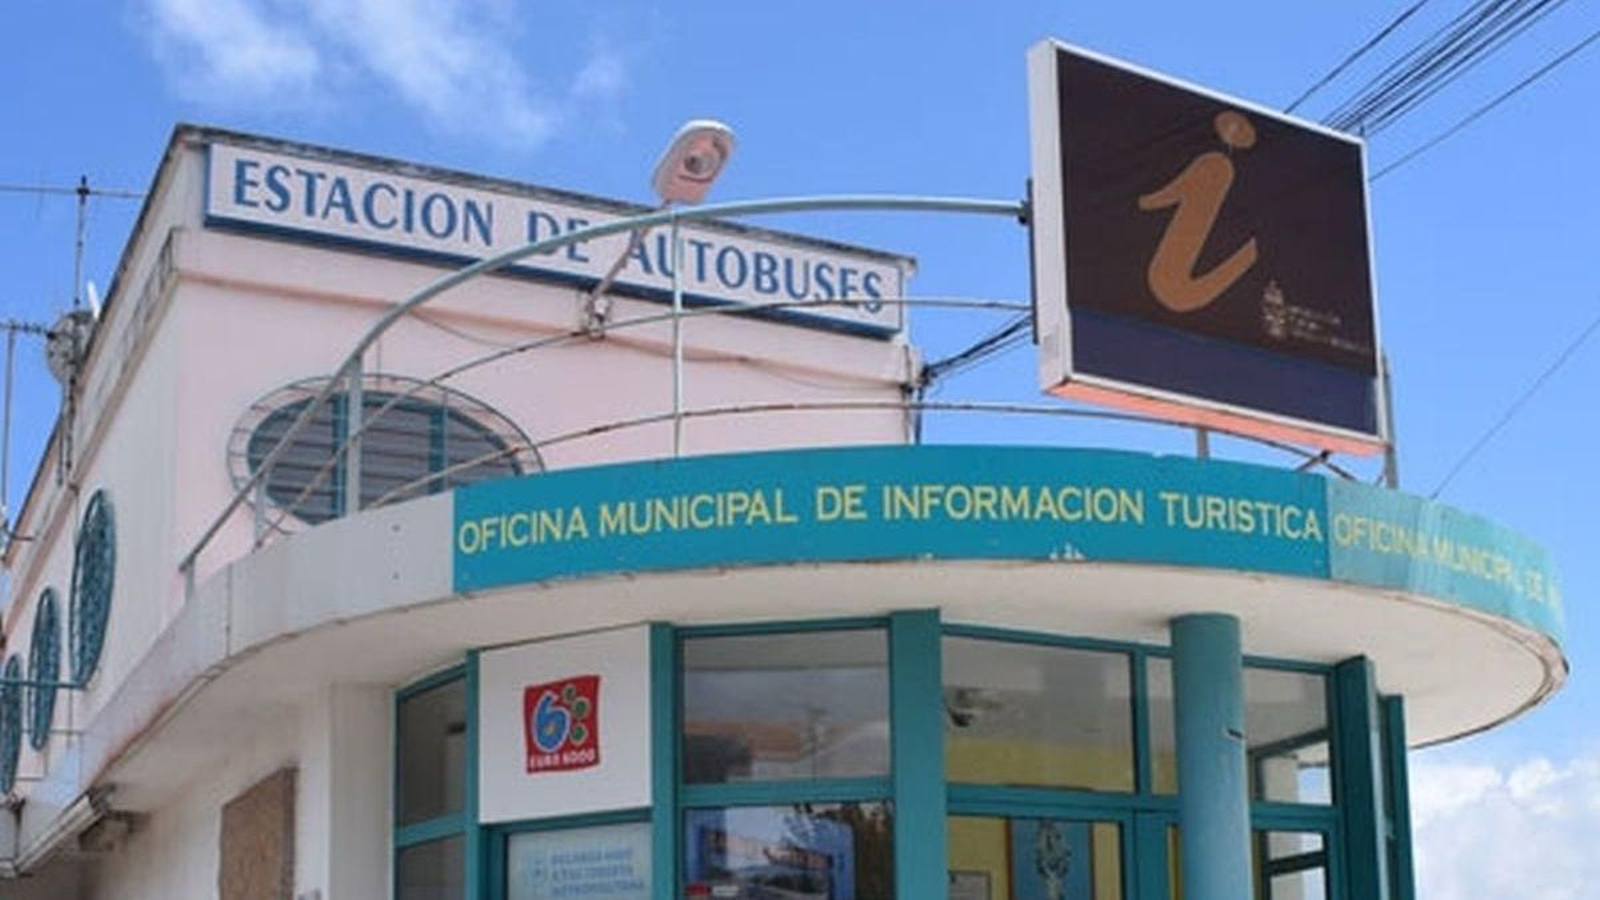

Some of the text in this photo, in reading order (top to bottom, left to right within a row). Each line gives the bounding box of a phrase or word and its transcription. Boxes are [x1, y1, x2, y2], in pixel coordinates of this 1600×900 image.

[233, 158, 883, 314] ESTACION DE AUTOBUSES
[458, 484, 1323, 555] OFICINA MUNICIPAL DE INFORMACION TURISTICA
